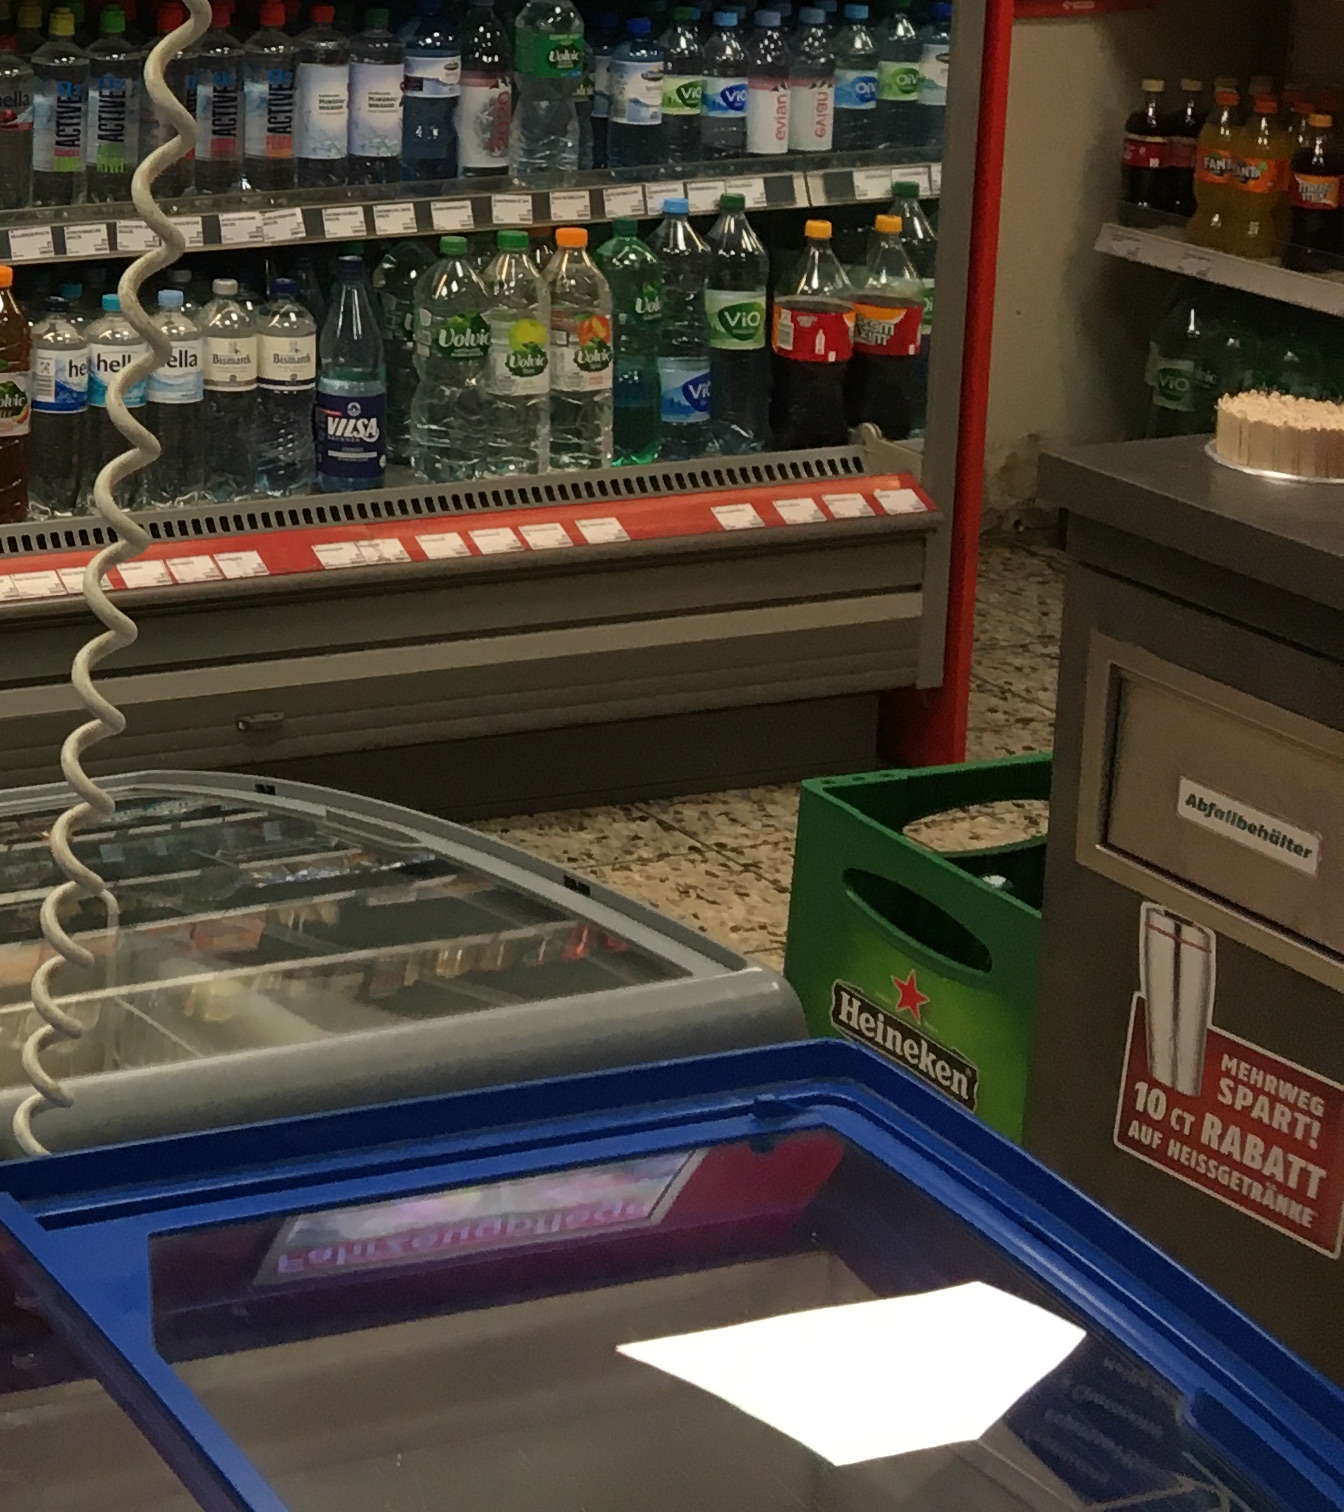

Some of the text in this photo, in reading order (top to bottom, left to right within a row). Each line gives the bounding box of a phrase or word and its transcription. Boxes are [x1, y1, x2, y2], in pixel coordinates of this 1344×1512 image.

[775, 93, 788, 142] evian
[326, 415, 380, 442] VILSA
[1184, 791, 1314, 861] Abfallbehälter
[837, 988, 972, 1102] Heineken
[1216, 1077, 1323, 1152] SPART!
[1220, 1051, 1326, 1119] MEHRWEG
[1127, 1118, 1315, 1230] AUF HEISSGETRÄNKE
[1134, 1081, 1327, 1200] 10 CT RABATT
